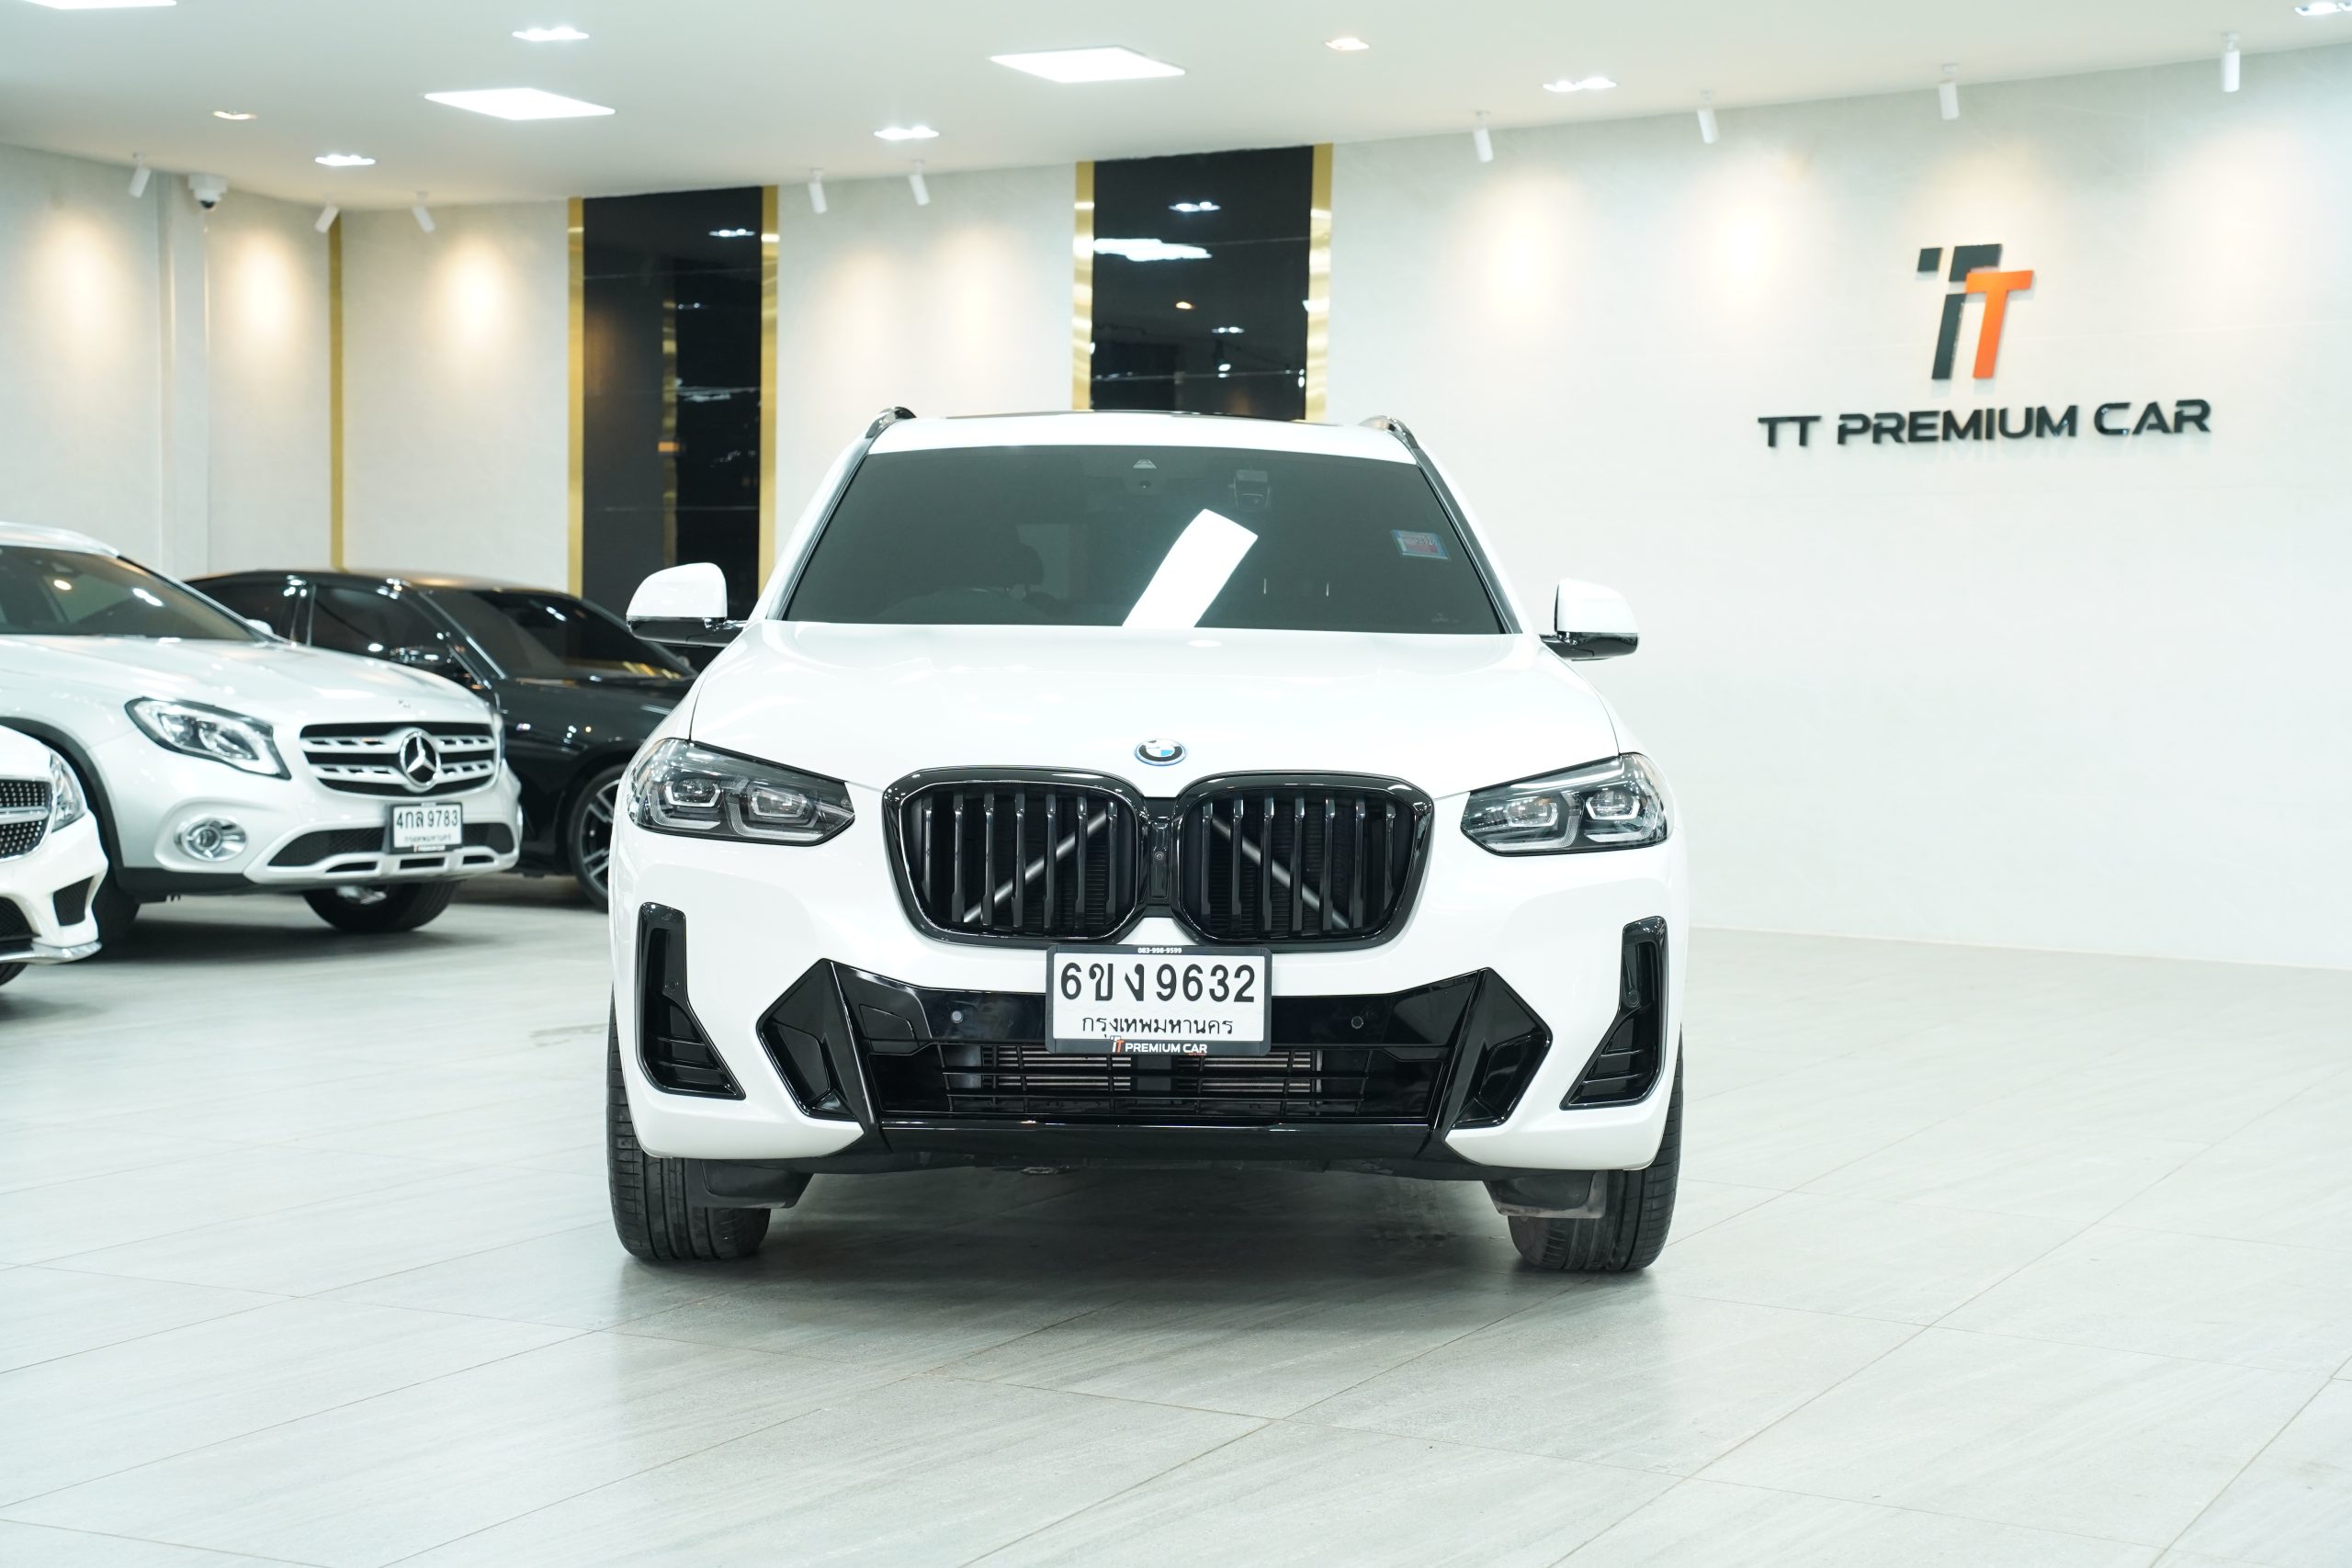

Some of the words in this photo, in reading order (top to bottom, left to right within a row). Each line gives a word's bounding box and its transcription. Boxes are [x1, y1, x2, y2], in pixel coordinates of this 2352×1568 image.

[1758, 415, 1822, 448] TT
[1837, 404, 2078, 446] PREMIUM
[2093, 399, 2211, 436] CAR
[427, 809, 458, 828] 9783
[1156, 963, 1255, 1003] 9632
[1082, 1017, 1233, 1038] กรุงเทพมหานคร
[1125, 1043, 1181, 1054] PREMIUM
[1182, 1043, 1208, 1054] CAR
